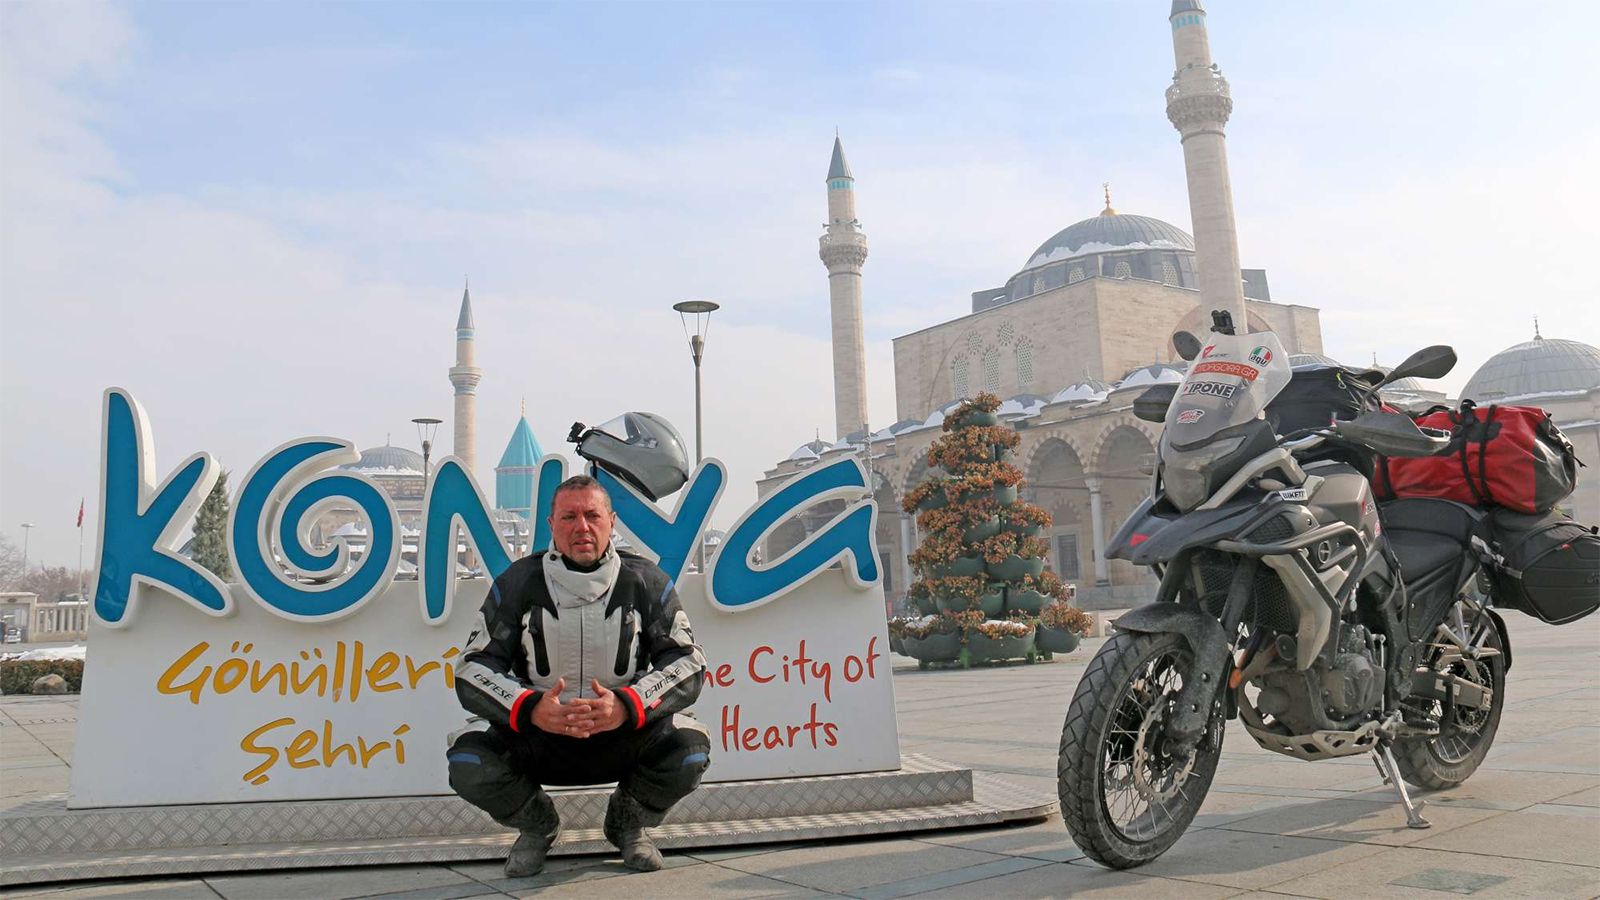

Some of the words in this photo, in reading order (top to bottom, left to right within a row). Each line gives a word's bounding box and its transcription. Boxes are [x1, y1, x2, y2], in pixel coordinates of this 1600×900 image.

[1188, 383, 1233, 397] IPONE
[156, 640, 460, 704] Gönülleri
[747, 639, 832, 703] City
[843, 636, 881, 683] of
[240, 717, 411, 786] Şehri
[721, 702, 839, 752] Hearts
